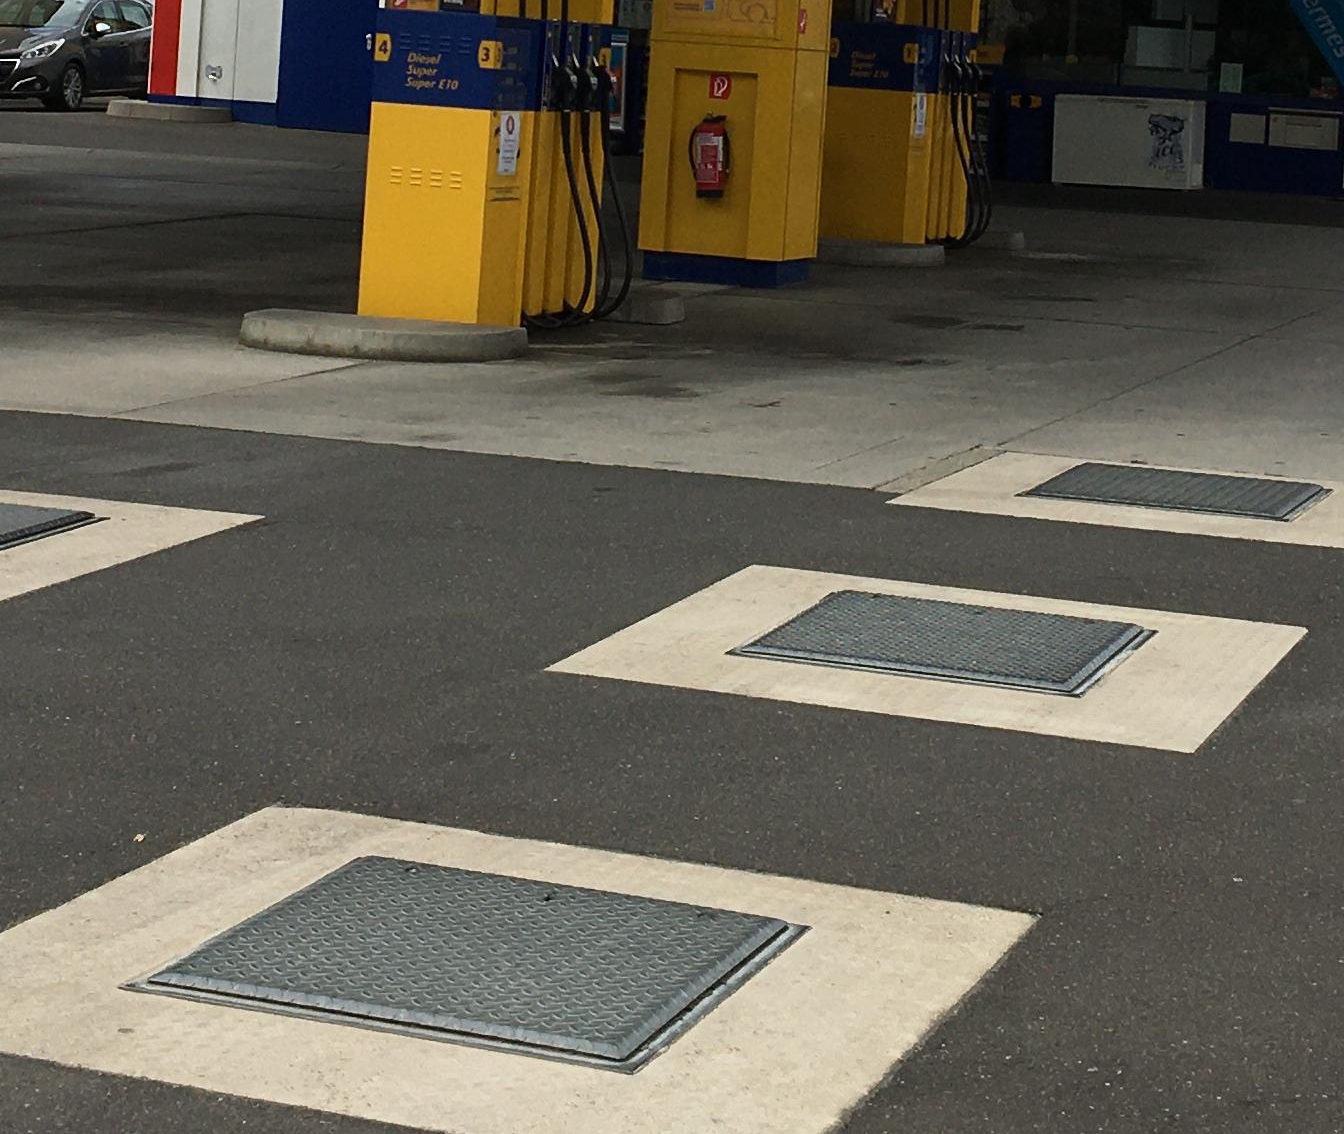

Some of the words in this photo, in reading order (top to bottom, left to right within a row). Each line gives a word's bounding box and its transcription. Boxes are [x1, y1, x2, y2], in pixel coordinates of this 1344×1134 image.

[378, 39, 389, 56] 4
[480, 47, 490, 62] 3
[407, 52, 442, 65] Diesel
[406, 65, 439, 77] Super
[405, 76, 437, 90] Super
[438, 78, 460, 91] E10
